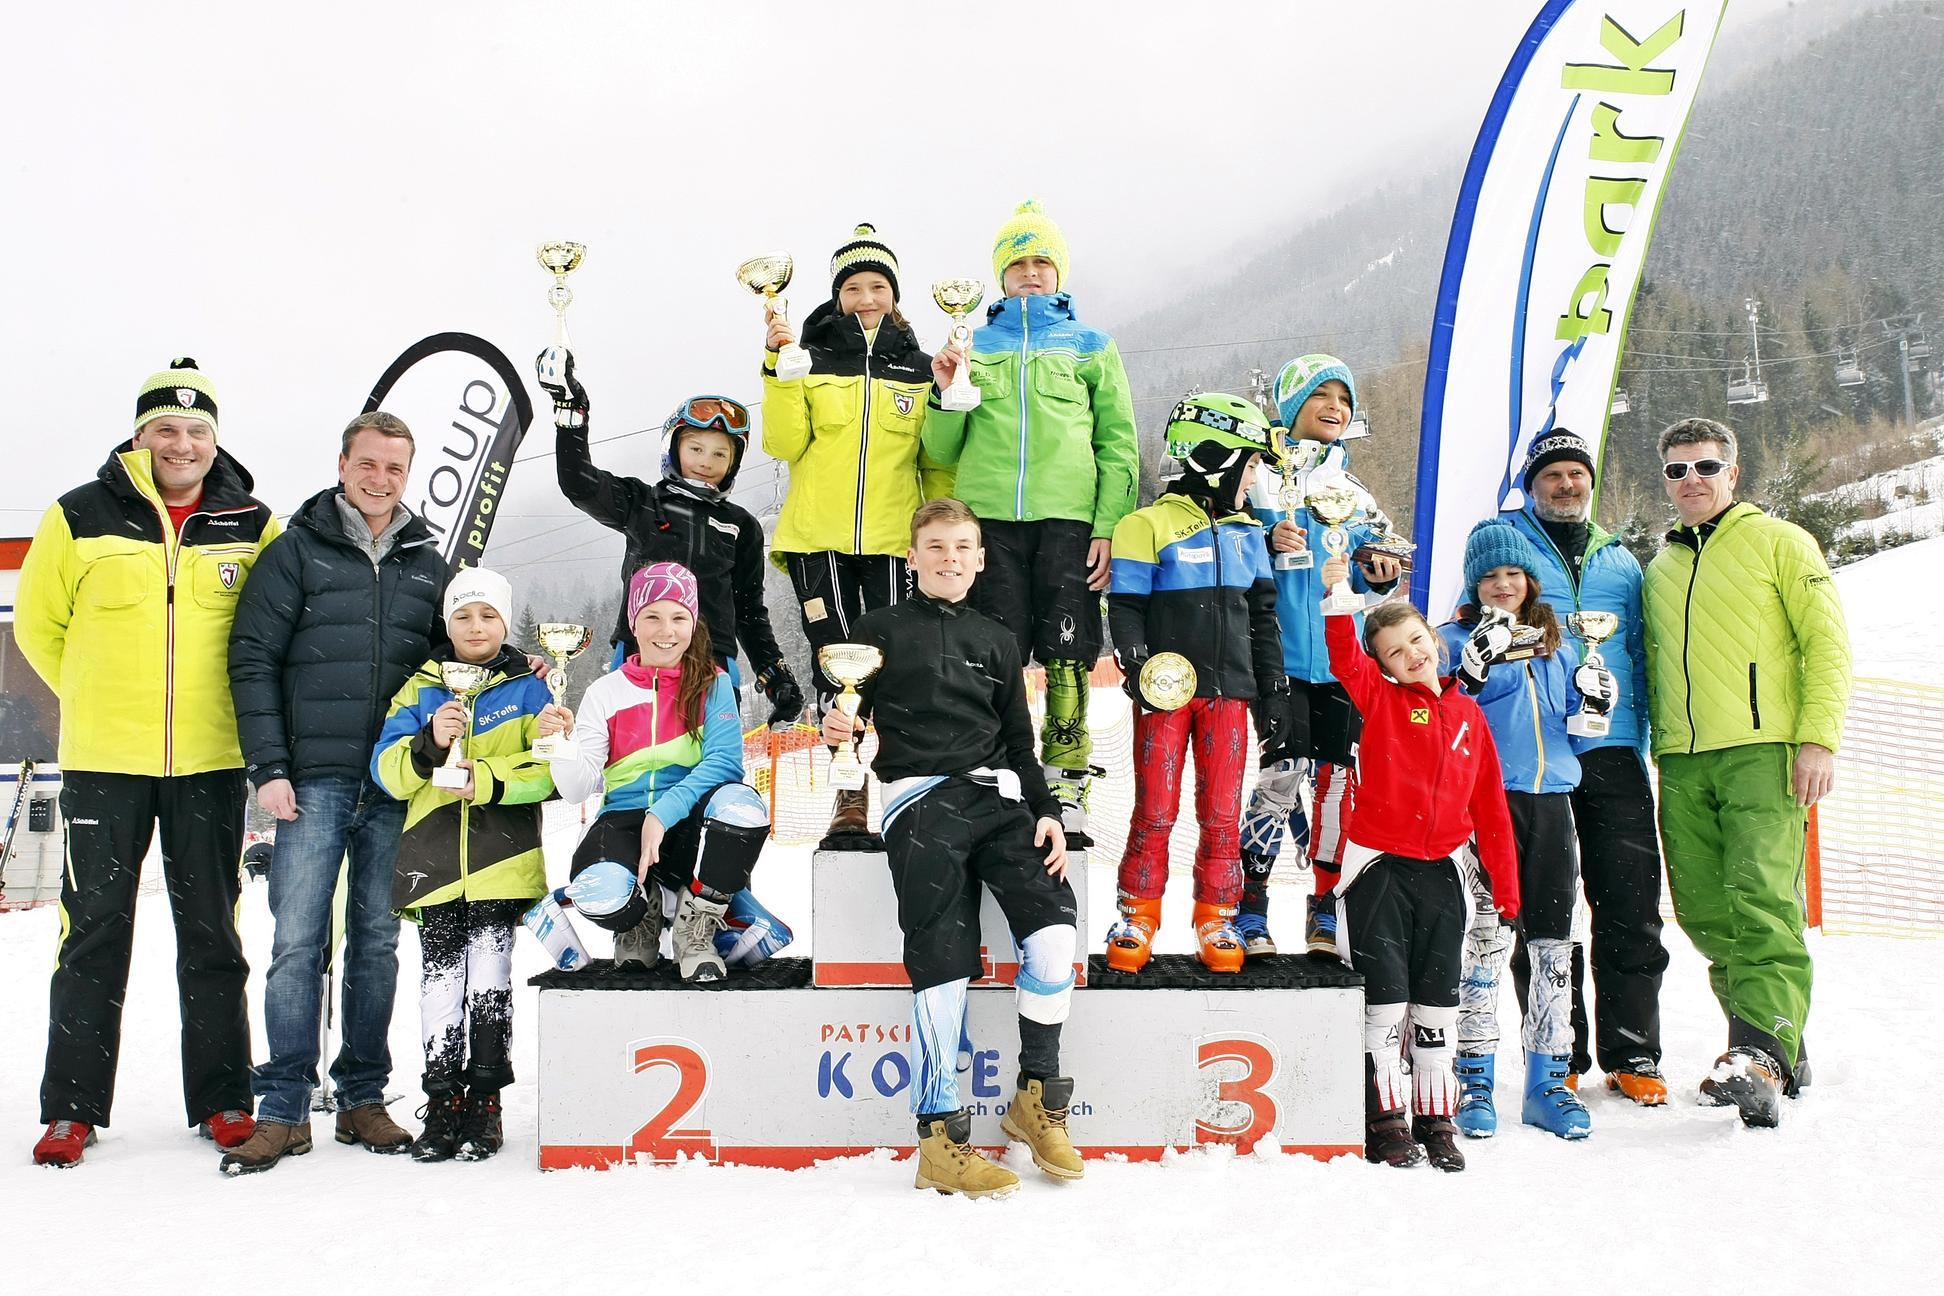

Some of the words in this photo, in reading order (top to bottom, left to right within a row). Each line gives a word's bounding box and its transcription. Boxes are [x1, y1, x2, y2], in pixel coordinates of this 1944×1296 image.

[467, 460, 506, 550] profit
[459, 590, 486, 600] odlo
[478, 703, 519, 727] SK-Telfs
[624, 1035, 719, 1162] 2
[1190, 1030, 1285, 1156] 3
